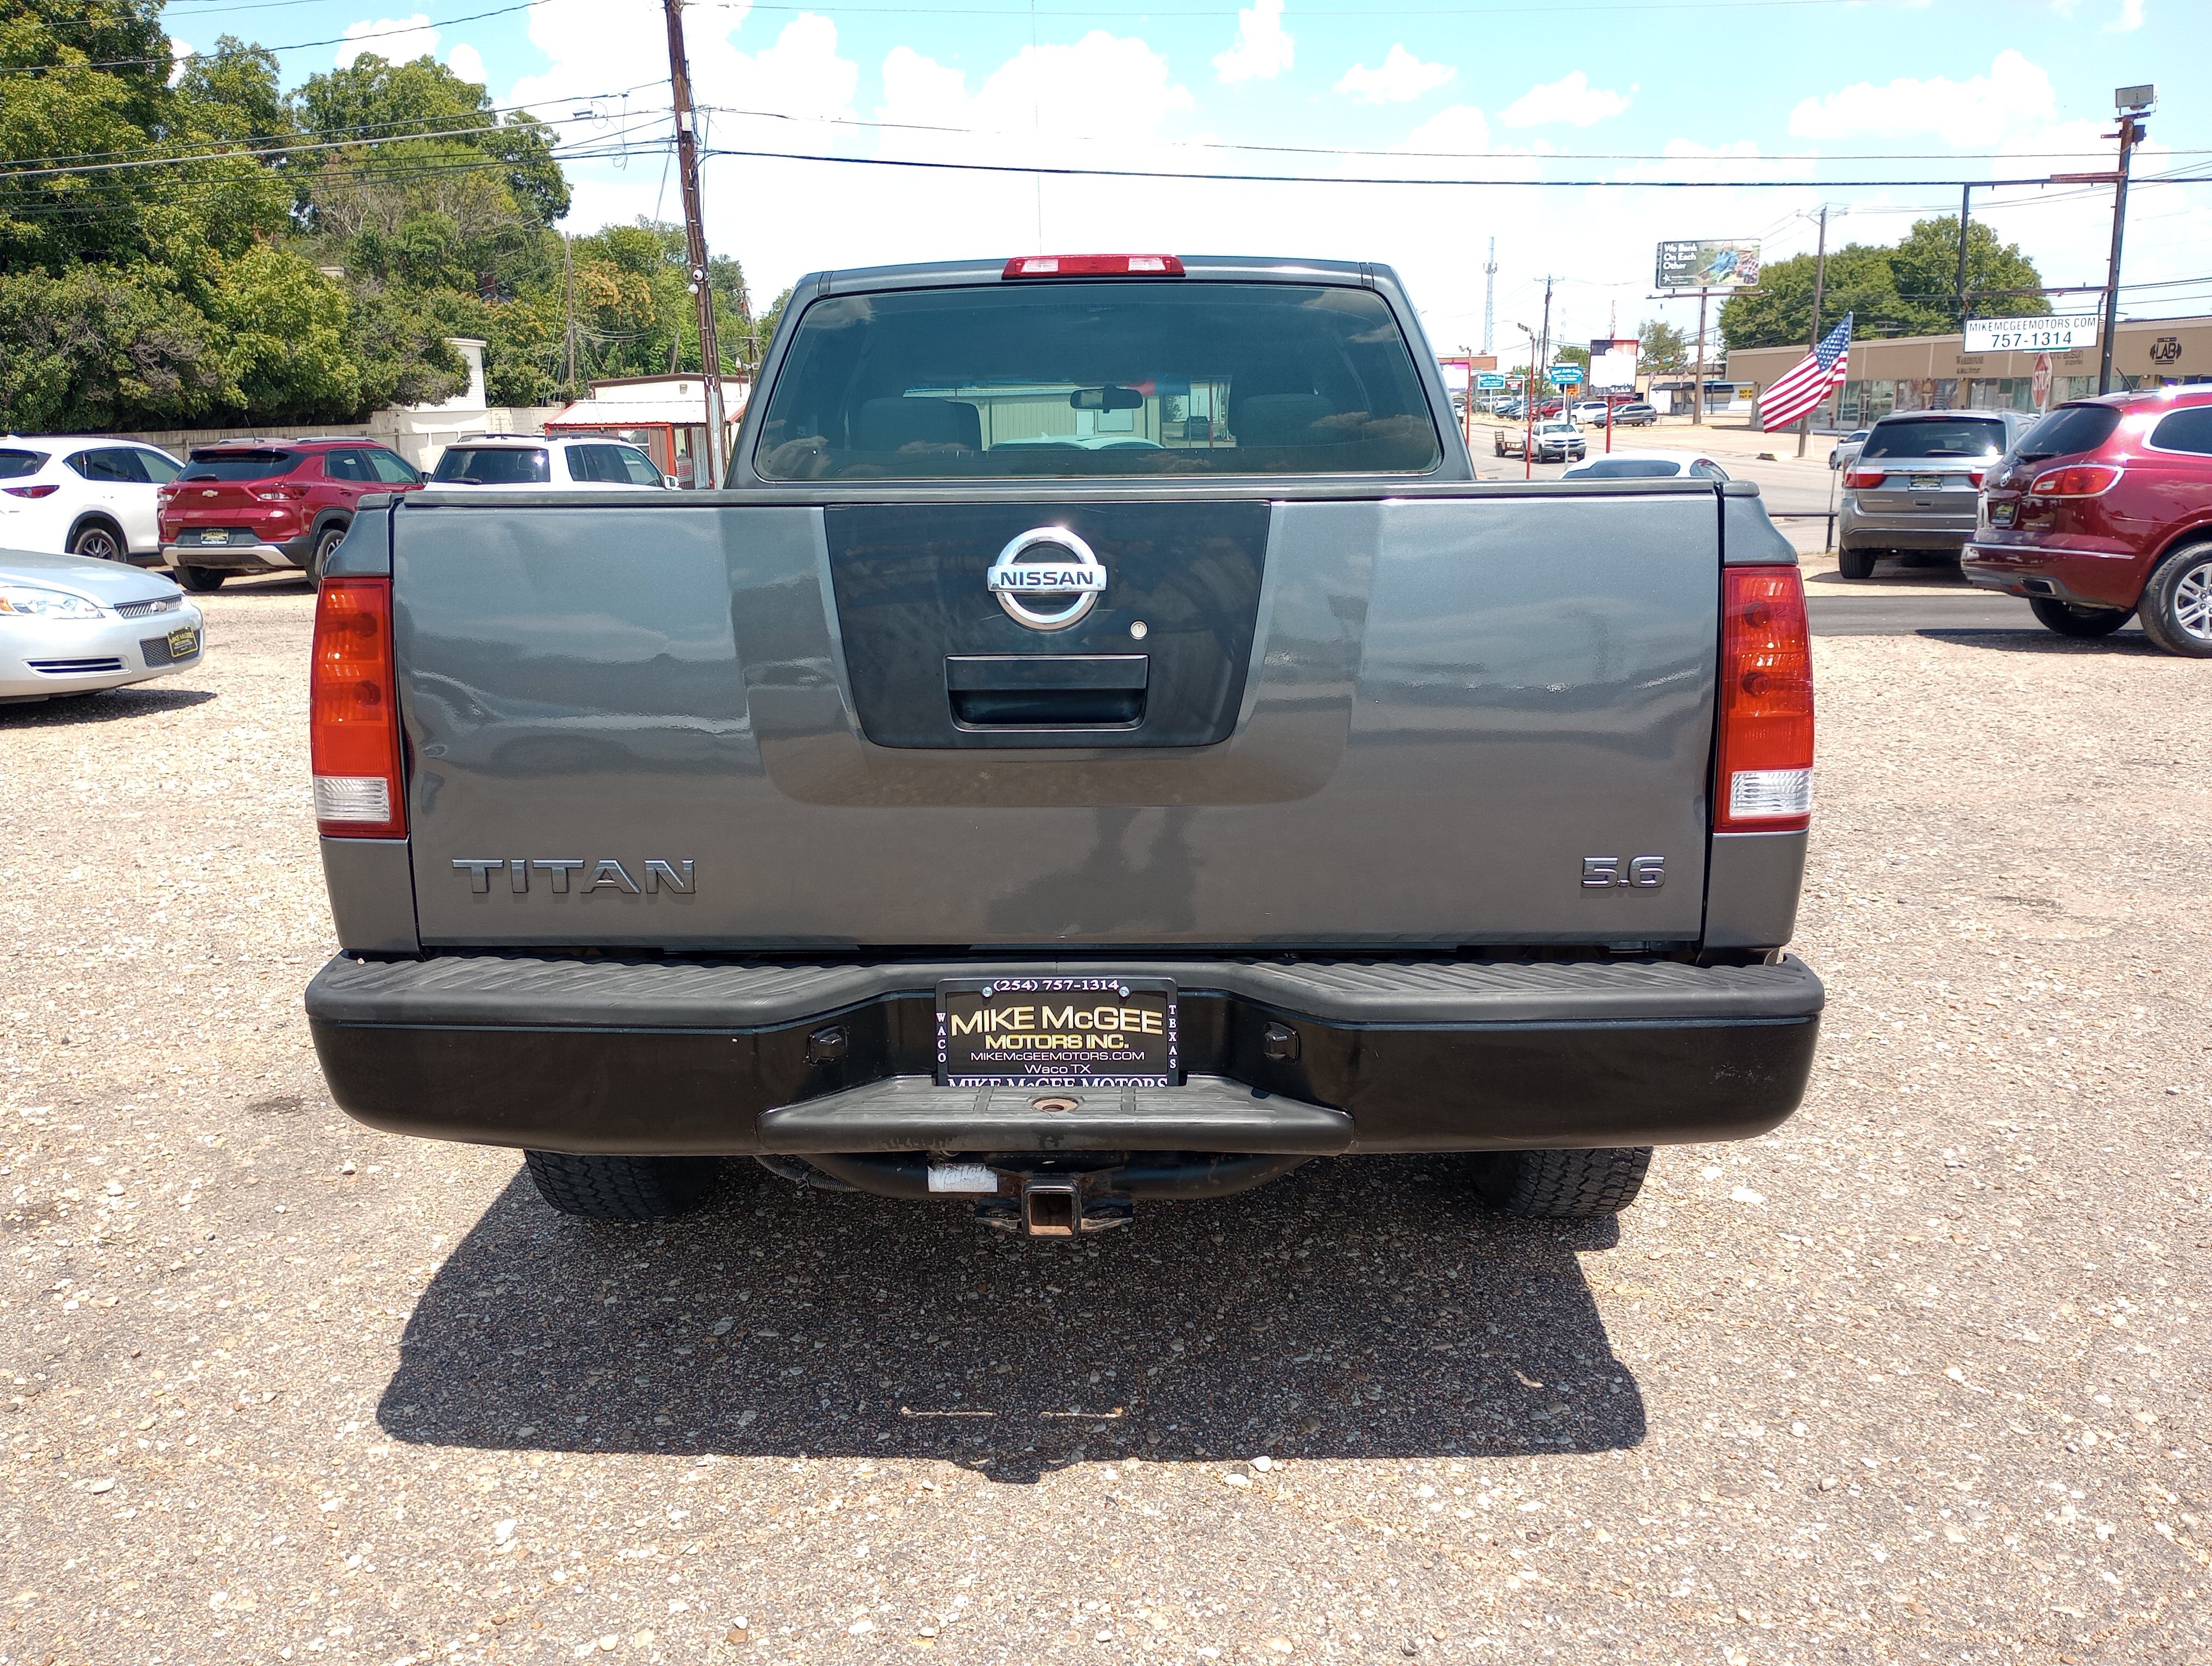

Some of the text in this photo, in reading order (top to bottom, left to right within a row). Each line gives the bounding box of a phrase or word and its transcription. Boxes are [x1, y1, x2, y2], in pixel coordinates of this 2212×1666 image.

[1663, 252, 1696, 261] On Each
[1663, 261, 1687, 270] Other
[1969, 318, 2095, 332] MIKEMCGEEMOTORS COM
[1991, 331, 2072, 348] 757-1314
[2156, 343, 2176, 359] LAB
[2034, 370, 2049, 391] STOP
[1001, 572, 1093, 586] NISSAN
[452, 858, 696, 894] TITAN
[1581, 855, 1665, 888] 5.6
[993, 979, 1119, 992] (254) 757-1314
[951, 1005, 1163, 1036] MIKE McGEE
[936, 1013, 947, 1062] WACO
[985, 1034, 1129, 1049] MOTORS INC.
[1168, 1004, 1178, 1069] TEXAS
[970, 1052, 1145, 1061] MIKEMcGEEMOTORS.COM
[1024, 1063, 1091, 1074] Waco TX
[948, 1078, 1002, 1087] MIKE
[1081, 1078, 1168, 1087] MOTORS
